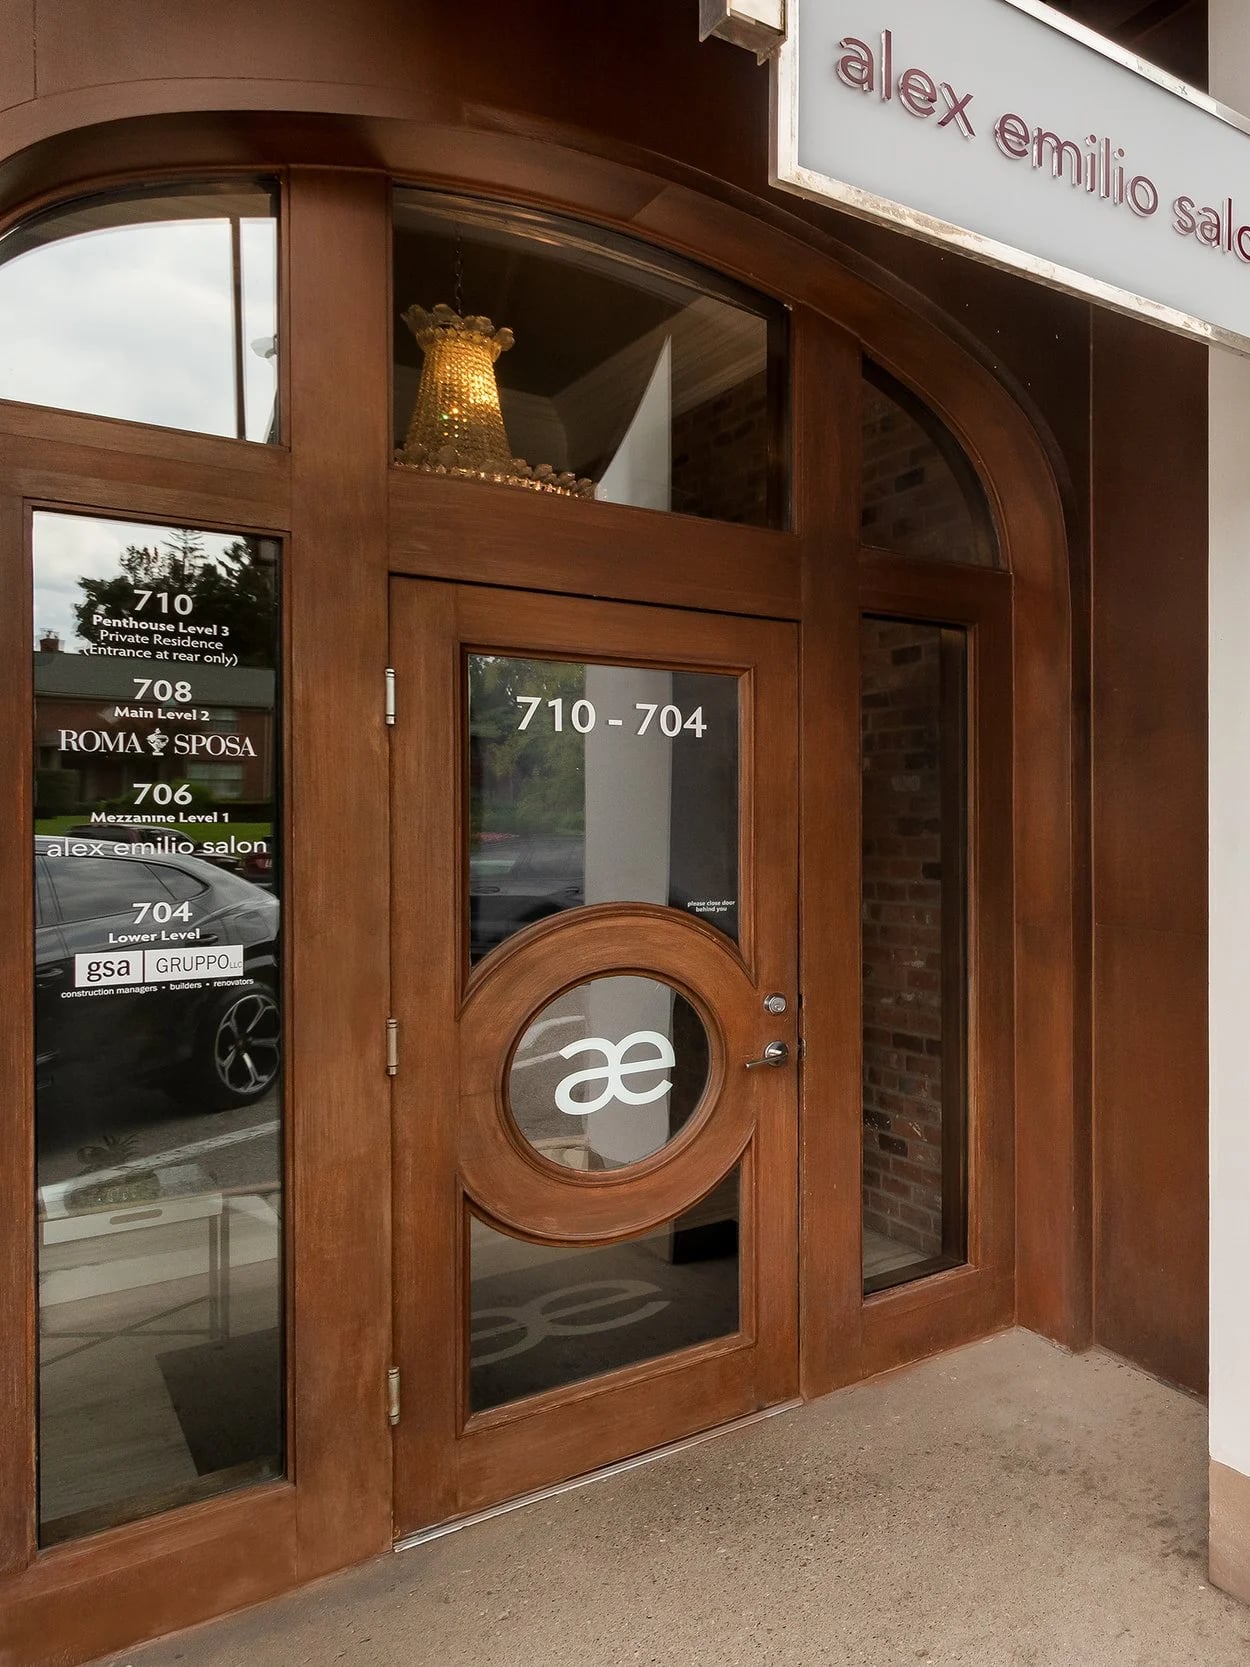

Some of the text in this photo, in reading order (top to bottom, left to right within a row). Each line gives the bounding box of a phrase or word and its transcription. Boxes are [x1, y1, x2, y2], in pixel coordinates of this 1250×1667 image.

[836, 29, 976, 140] alex
[994, 111, 1159, 218] emilio
[133, 589, 194, 616] 710
[92, 614, 230, 637] Penthouse Level 3
[100, 630, 224, 650] Private Residence
[83, 643, 238, 667] (Entrance at rear only)
[133, 678, 193, 702] 708
[114, 706, 210, 722] Main Level 2
[516, 696, 596, 733] 710
[635, 703, 707, 738] 704
[58, 729, 257, 757] ROMA SPOSA
[133, 783, 193, 805] 706
[179, 812, 218, 823] Level
[222, 812, 230, 823] 1
[46, 835, 267, 857] alex emilio salon
[132, 901, 193, 924] 704
[109, 928, 201, 944] Lower Level
[86, 958, 131, 982] gsa
[156, 954, 230, 974] GRUPPO
[60, 978, 254, 998] construction managers builders renovators
